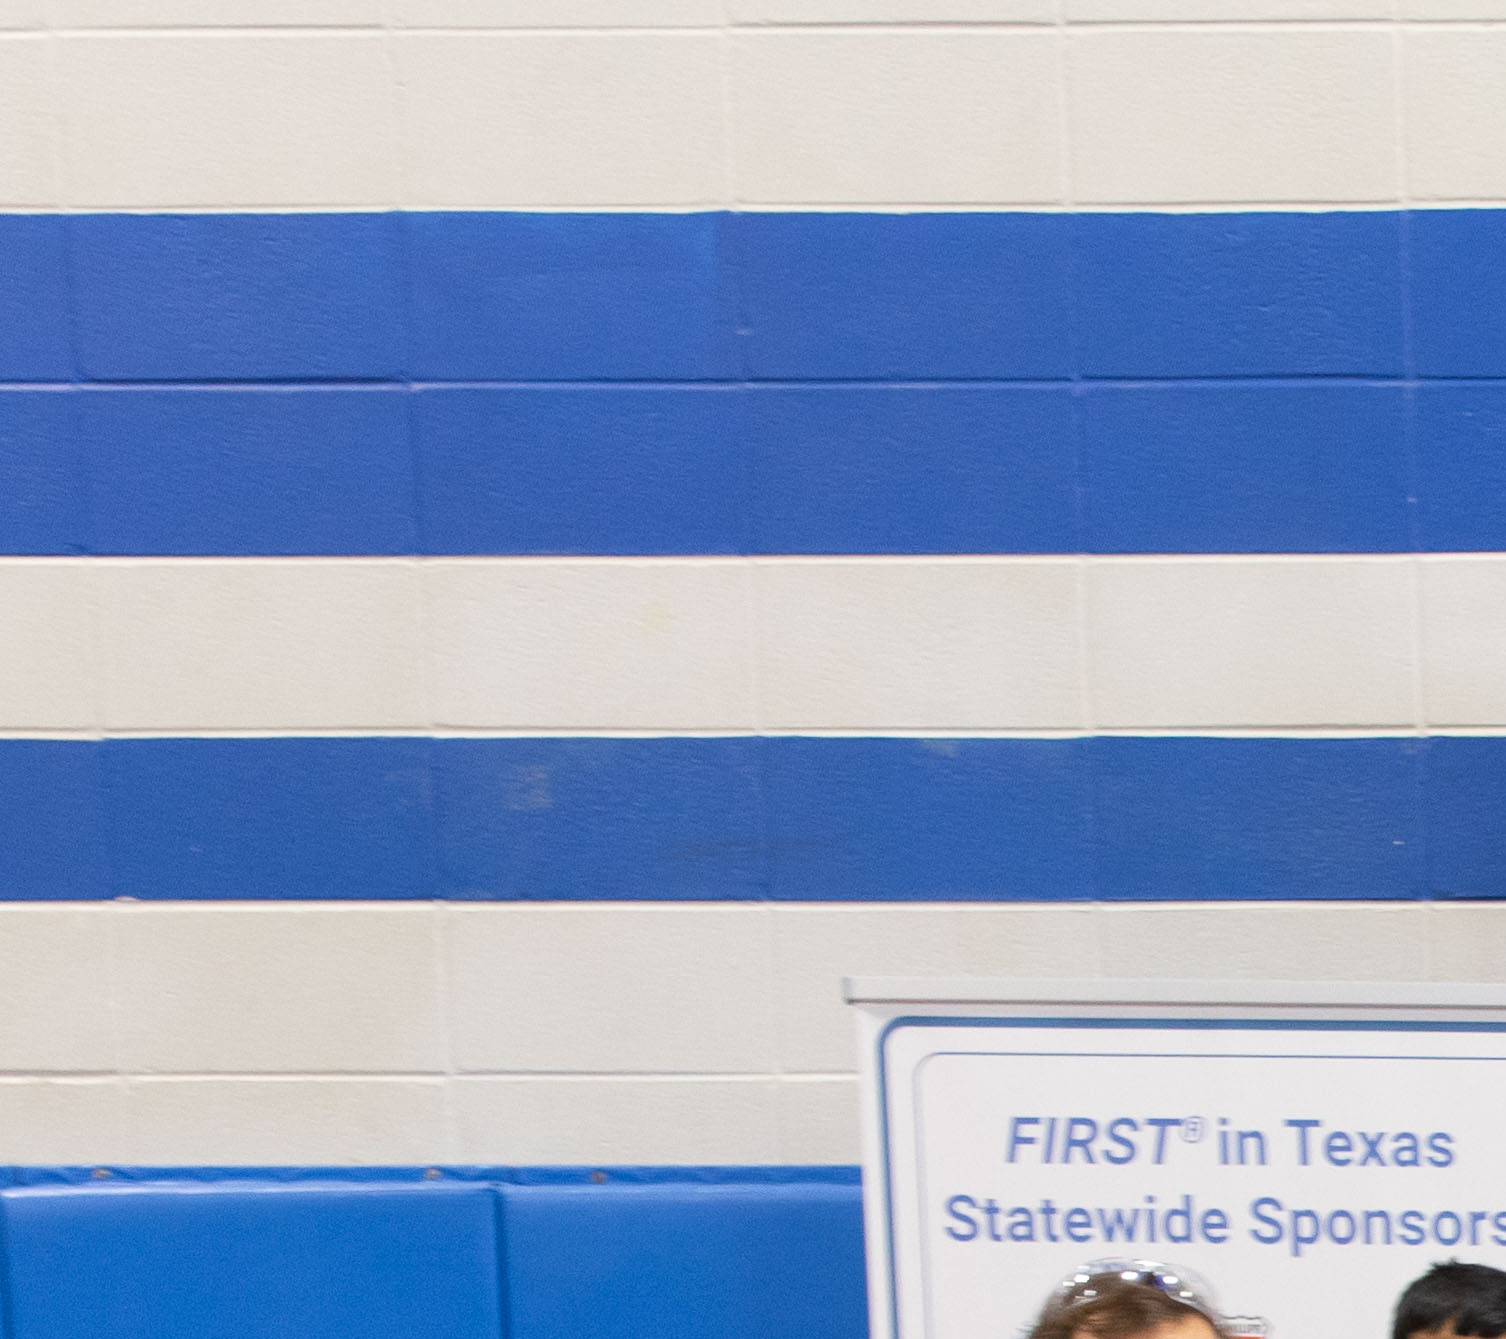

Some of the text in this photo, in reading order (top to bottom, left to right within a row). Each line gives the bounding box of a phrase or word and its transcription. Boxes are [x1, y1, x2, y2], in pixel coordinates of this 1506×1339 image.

[1218, 1118, 1266, 1165] in
[1285, 1119, 1456, 1168] Texas
[944, 1195, 1230, 1244] Statewide
